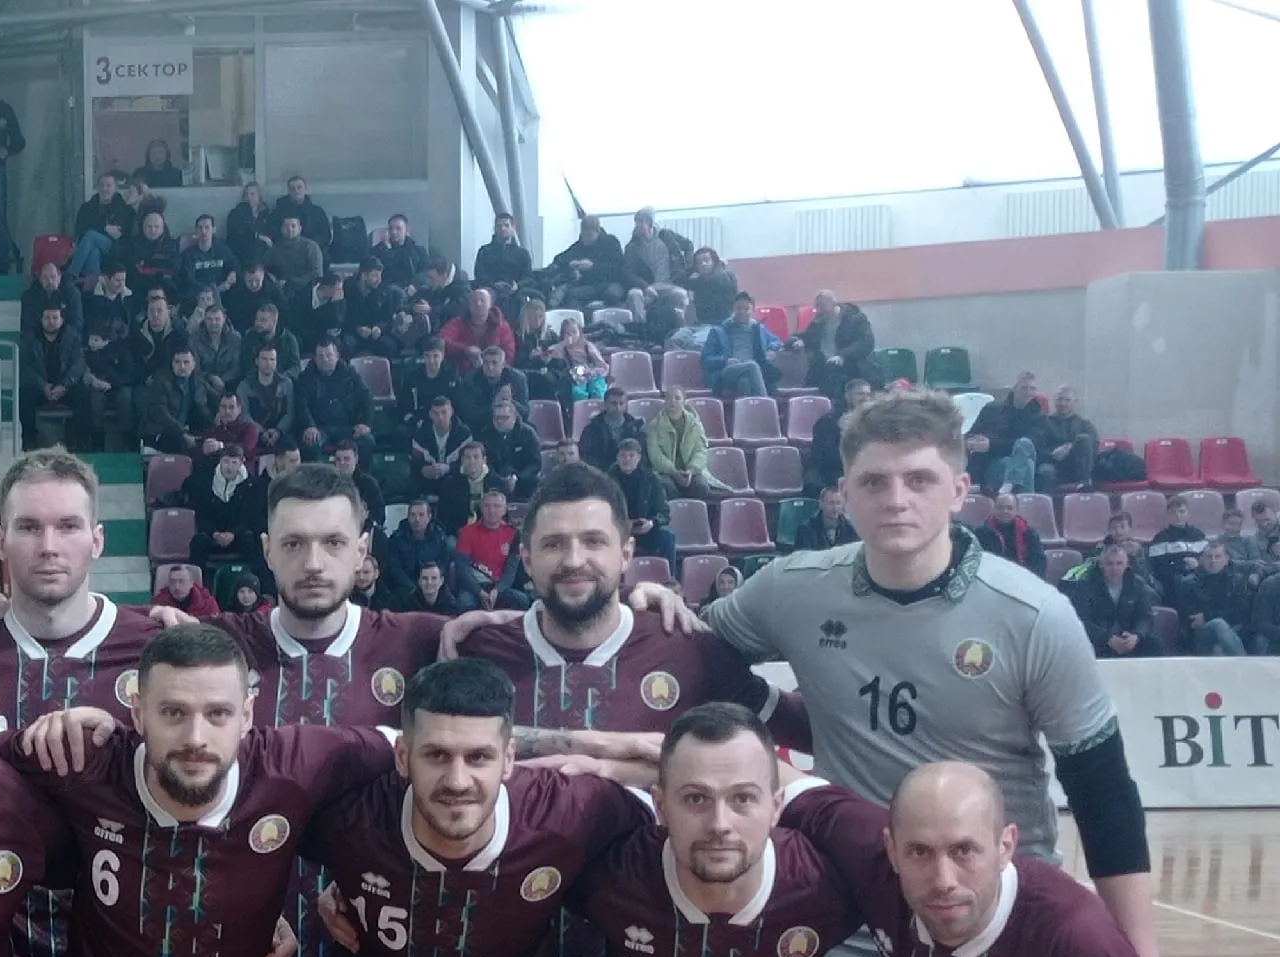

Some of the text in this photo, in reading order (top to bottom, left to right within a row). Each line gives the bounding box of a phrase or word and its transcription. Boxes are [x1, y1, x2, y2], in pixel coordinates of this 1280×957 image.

[96, 56, 188, 85] 3 СЕКТОР
[859, 675, 917, 735] 16
[91, 849, 121, 906] 6
[348, 895, 408, 951] 15
